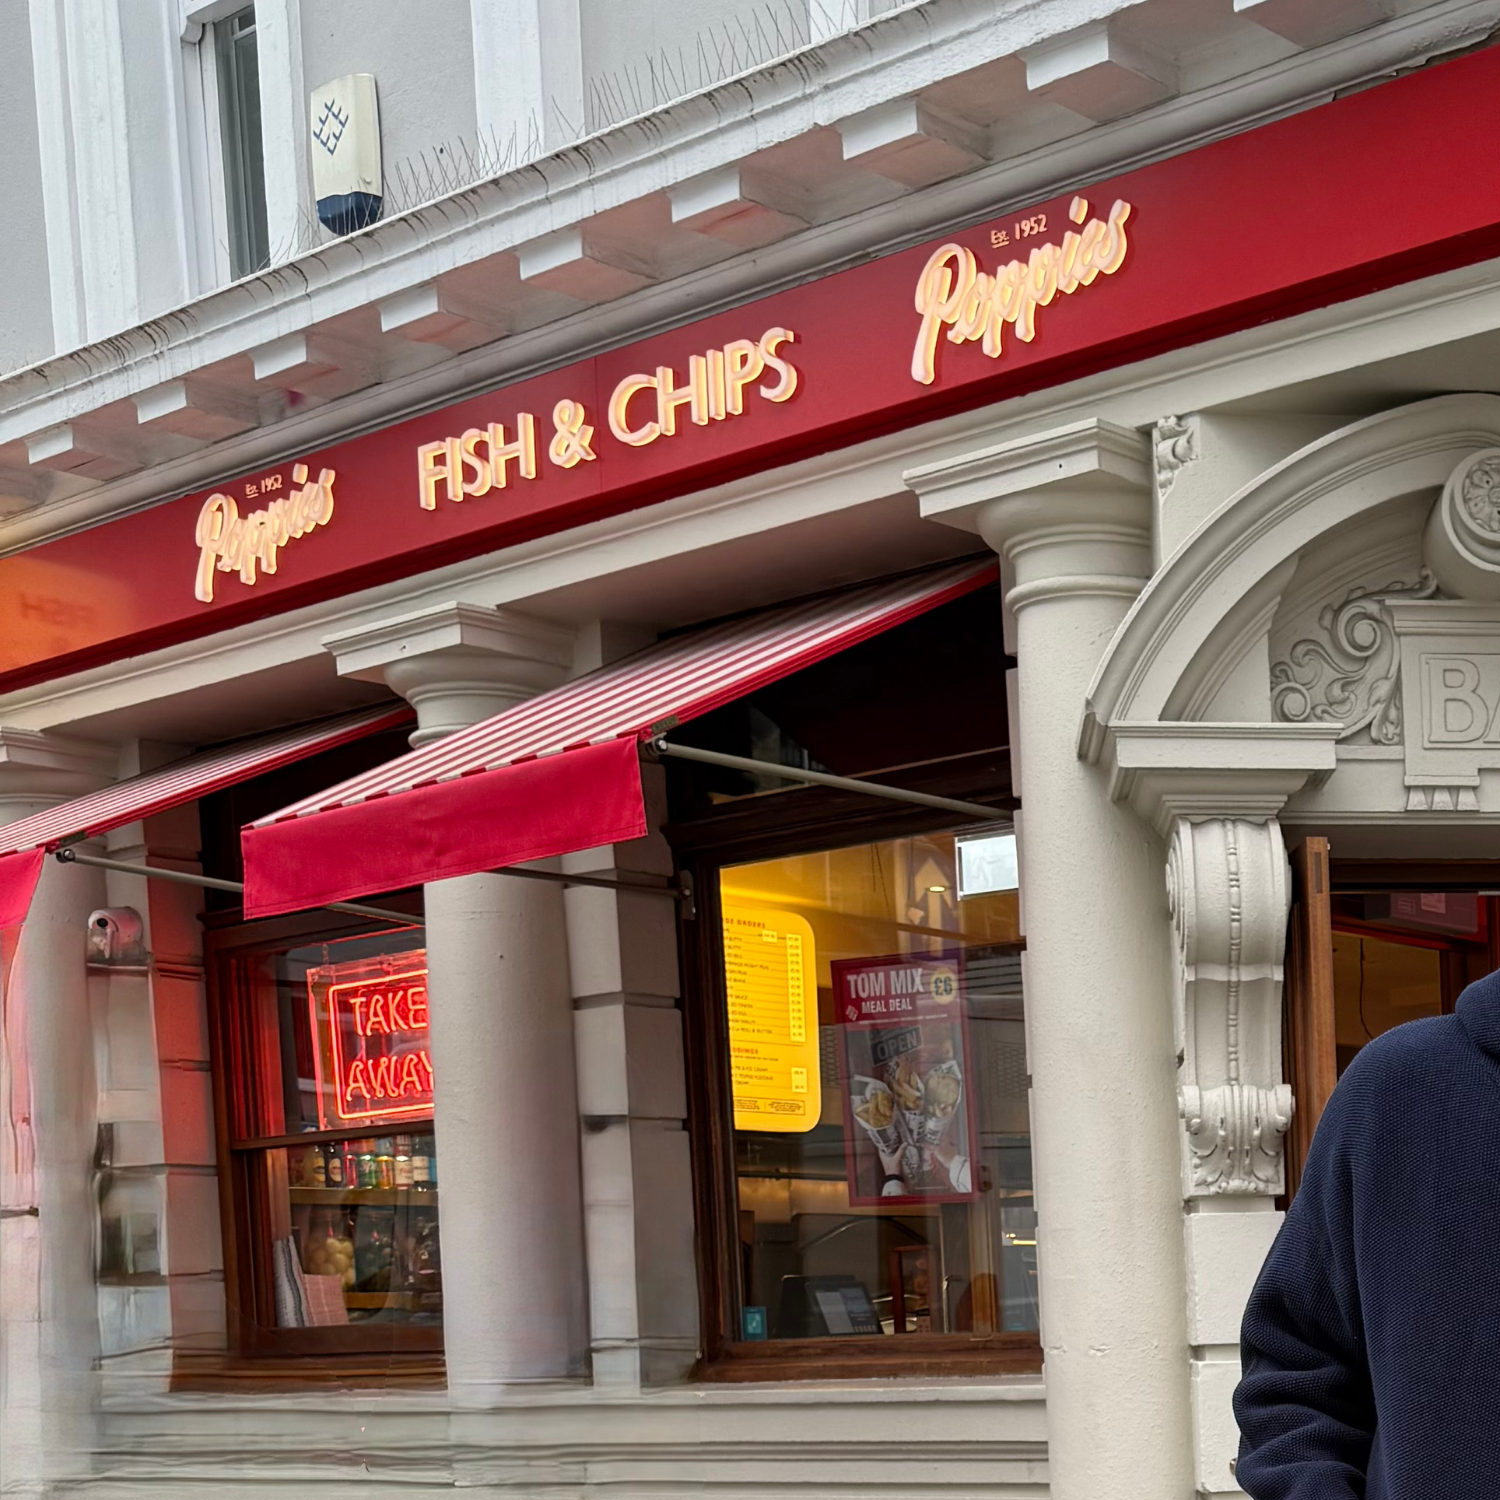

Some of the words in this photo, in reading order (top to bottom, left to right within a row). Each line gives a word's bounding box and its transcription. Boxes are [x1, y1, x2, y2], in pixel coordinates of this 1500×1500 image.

[1014, 214, 1048, 240] 1952
[911, 196, 1131, 384] Poppies
[417, 411, 537, 511] FISH
[548, 398, 597, 469] &
[607, 326, 798, 447] CHIPS
[846, 971, 886, 999] TOM
[889, 967, 924, 996] MIX
[933, 976, 953, 996] £6
[349, 987, 428, 1036] TAKE
[861, 1000, 887, 1014] MEAL
[889, 998, 912, 1012] DEAL
[876, 1030, 918, 1061] OPEN
